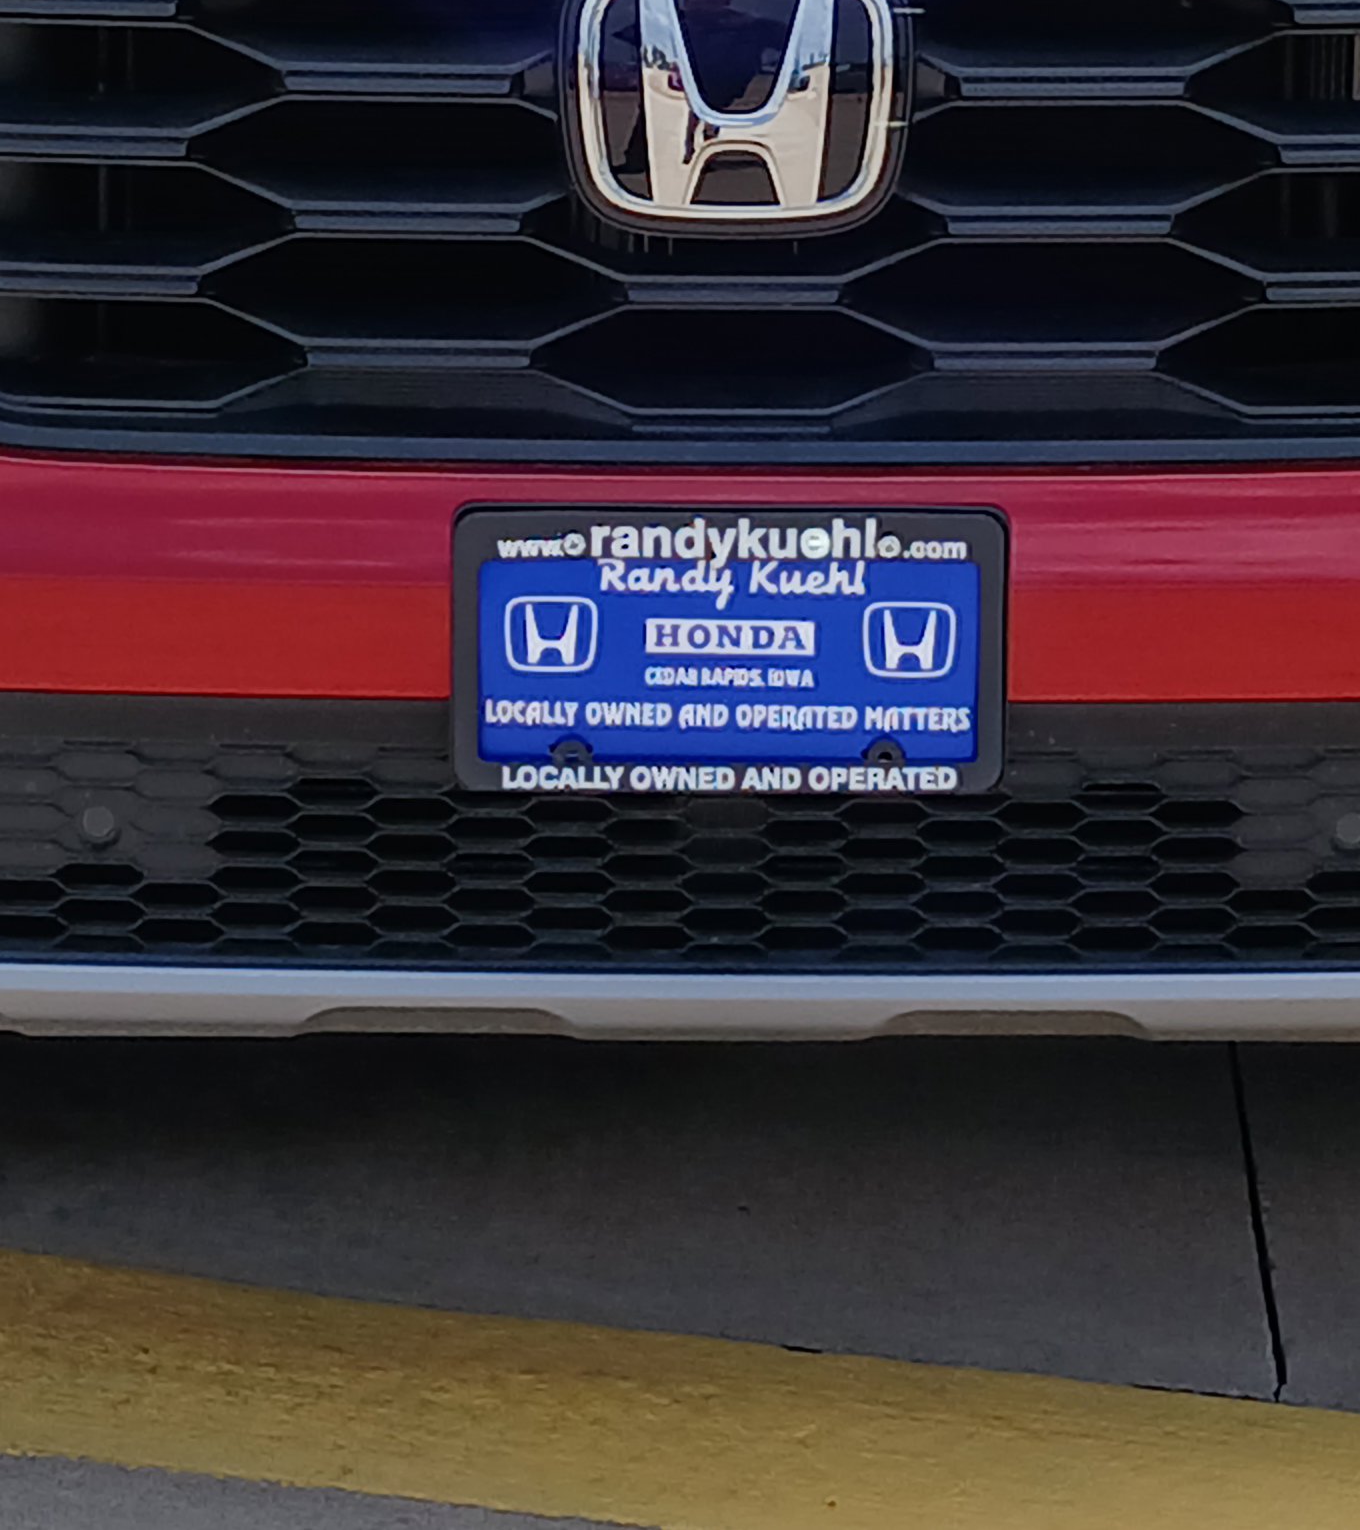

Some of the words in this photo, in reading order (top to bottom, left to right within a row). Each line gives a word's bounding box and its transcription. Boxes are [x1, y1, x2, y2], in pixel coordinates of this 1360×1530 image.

[597, 558, 735, 610] Randy
[748, 561, 866, 595] Kuehl
[652, 624, 808, 651] HONDA
[767, 667, 815, 688] IOWA
[485, 699, 578, 726] LOCALLY
[585, 701, 672, 726] OWNED
[678, 703, 729, 729] AND
[735, 704, 858, 731] OPERATED
[864, 706, 971, 732] MATTERS
[501, 765, 624, 790] LOCALLY
[629, 766, 736, 790] OWNED
[740, 766, 802, 791] AND
[807, 766, 958, 791] OPERATED
